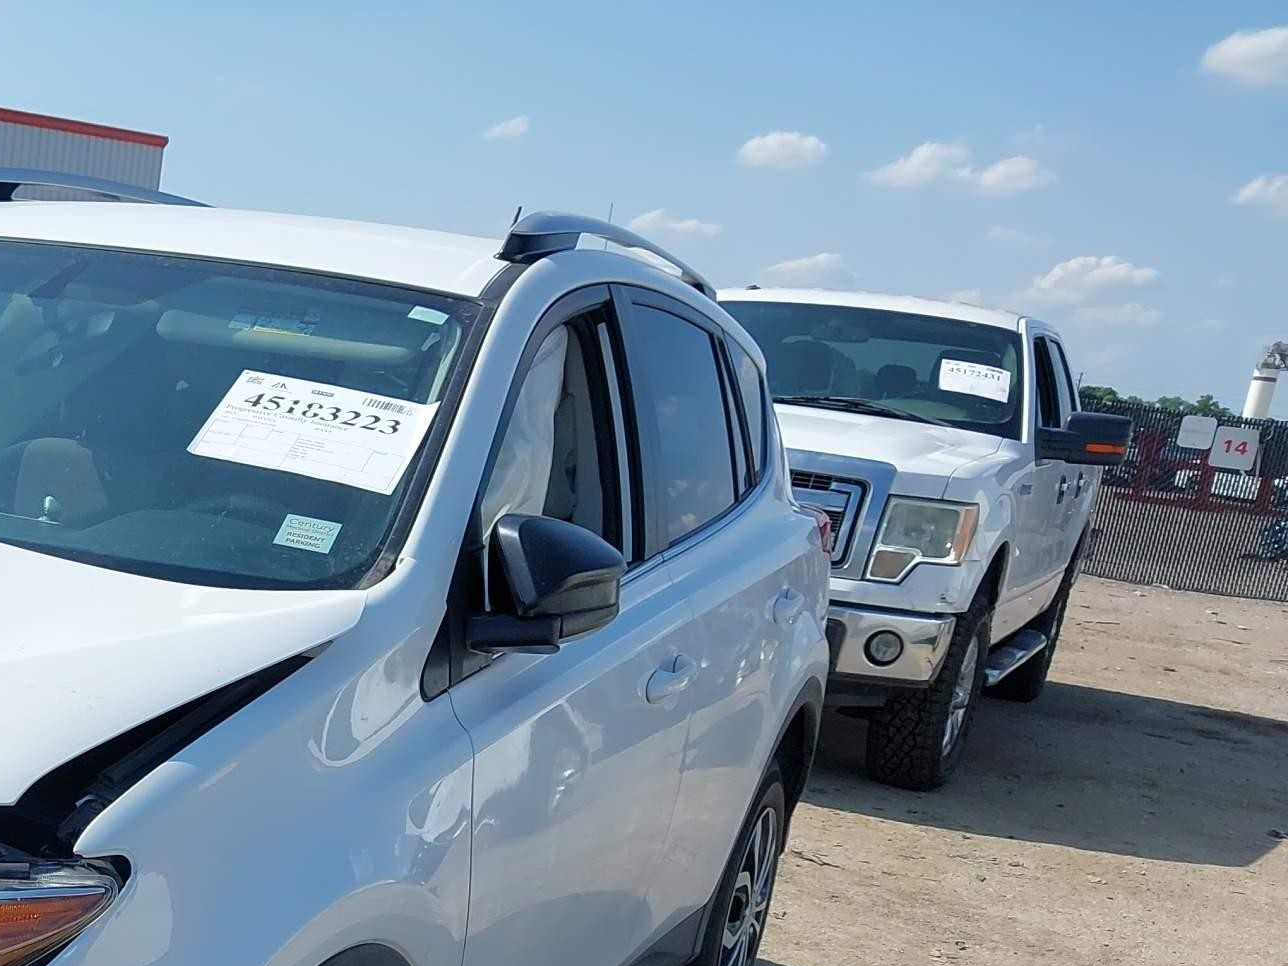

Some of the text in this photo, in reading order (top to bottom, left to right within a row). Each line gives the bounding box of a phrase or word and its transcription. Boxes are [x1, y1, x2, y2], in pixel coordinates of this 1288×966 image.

[244, 393, 401, 434] 45183223
[1223, 439, 1249, 455] 14
[289, 518, 335, 534] Century
[285, 538, 321, 549] PARKING
[287, 531, 326, 543] RESIDENT
